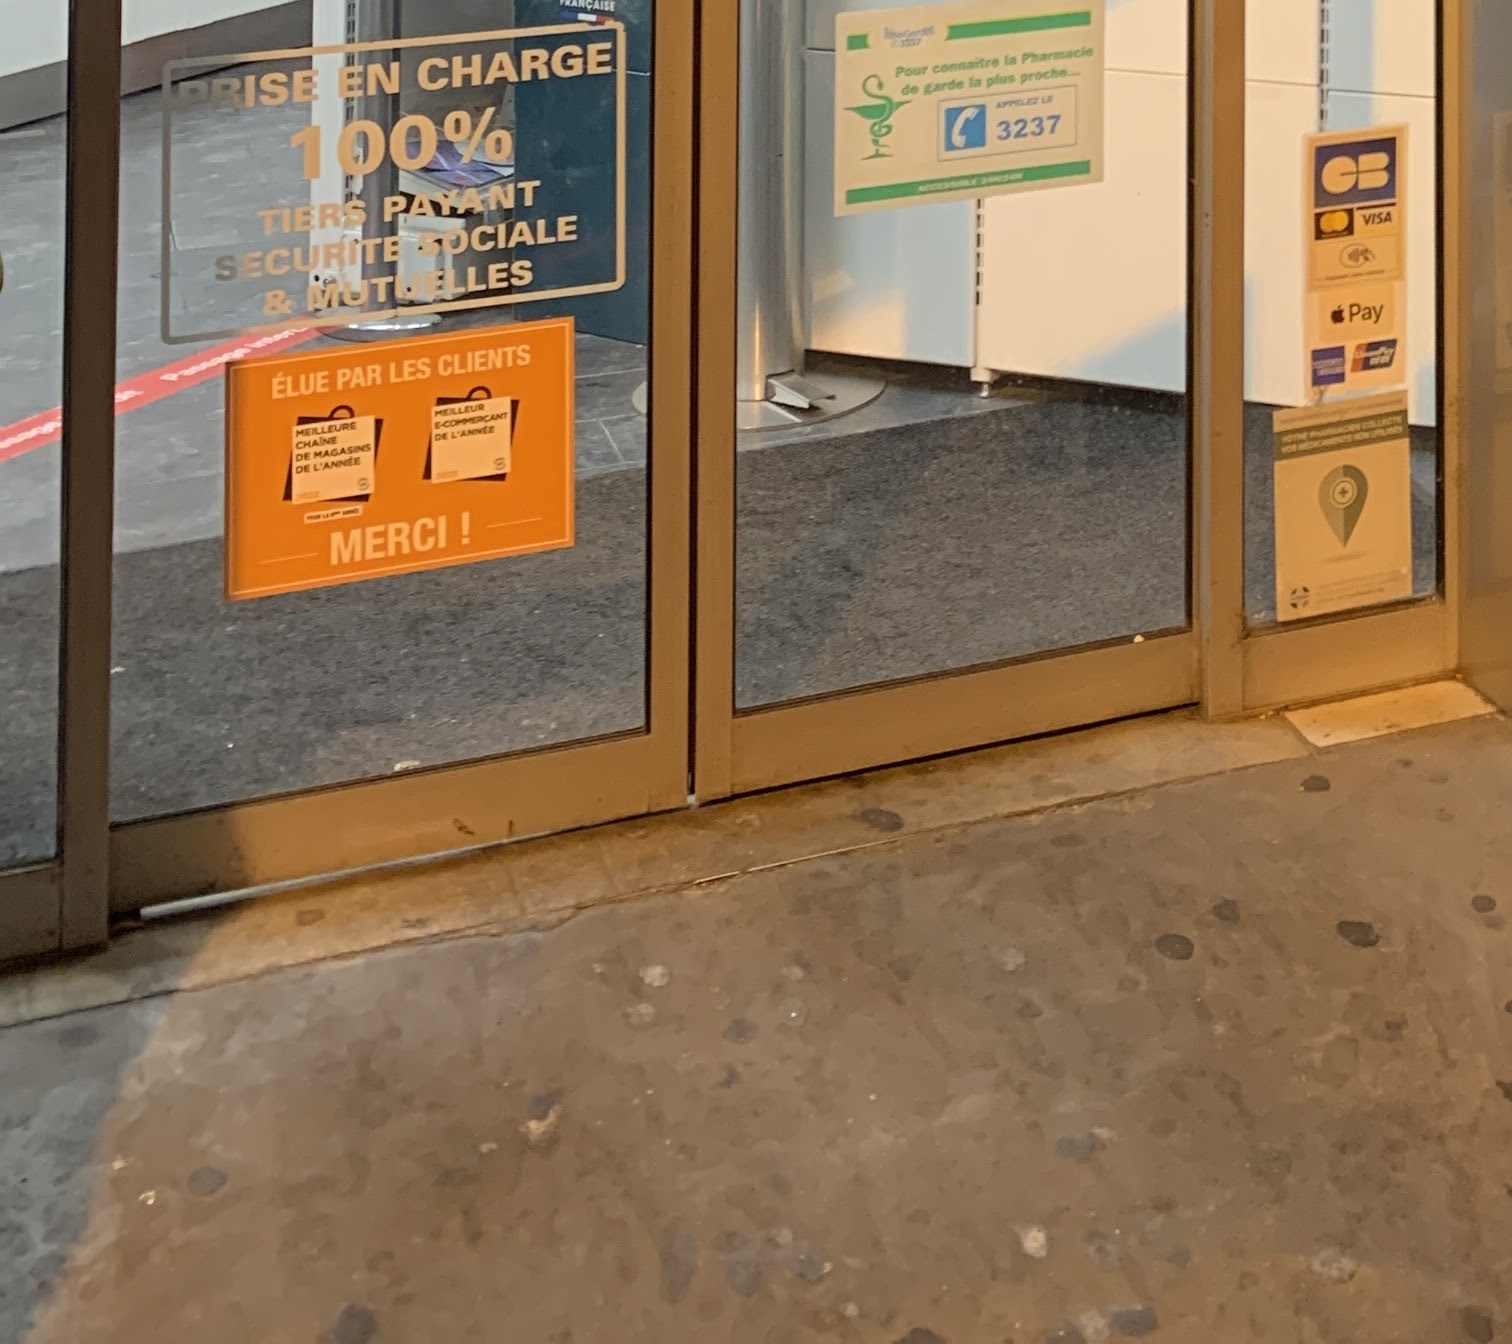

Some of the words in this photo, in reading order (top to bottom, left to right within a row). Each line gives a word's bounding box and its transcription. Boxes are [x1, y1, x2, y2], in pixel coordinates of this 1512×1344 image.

[895, 66, 928, 78] Pour
[1004, 55, 1017, 67] la
[1021, 45, 1094, 61] Pharmacie
[178, 68, 319, 110] PRISE
[338, 61, 399, 100] EN
[416, 42, 613, 91] CHARGE
[901, 85, 919, 96] de
[923, 77, 964, 96] garde
[969, 75, 981, 88] la
[986, 73, 1016, 89] plus
[995, 96, 1039, 109] APPELEZ
[996, 114, 1061, 141] 3237
[290, 106, 513, 181] 100%
[1321, 151, 1390, 195] CB
[258, 199, 367, 236] TIERS
[383, 180, 541, 222] PAYANT
[1361, 210, 1393, 226] VISA
[214, 236, 399, 282] SECURITE
[418, 215, 578, 258] SOCIALE
[264, 288, 291, 315] &
[307, 259, 533, 310] MUTUELLES
[1348, 302, 1385, 325] Pay
[271, 370, 330, 400] ÉLUE
[336, 363, 382, 391] PAR
[389, 357, 431, 384] LES
[438, 344, 532, 375] CLIENTS
[434, 403, 485, 418] MEILLEUR
[434, 411, 508, 430] E-COMMERÇANT
[296, 421, 357, 438] MEILLEURE
[434, 432, 448, 442] DE
[451, 425, 495, 439] L'ANNÉE
[295, 435, 338, 450] CHAÎNE
[295, 452, 310, 463] DE
[313, 443, 372, 459] MAGASINS
[295, 464, 310, 475] DE
[313, 456, 361, 472] L'ANNÉE
[329, 516, 447, 566] MERCI
[460, 511, 471, 546] !
